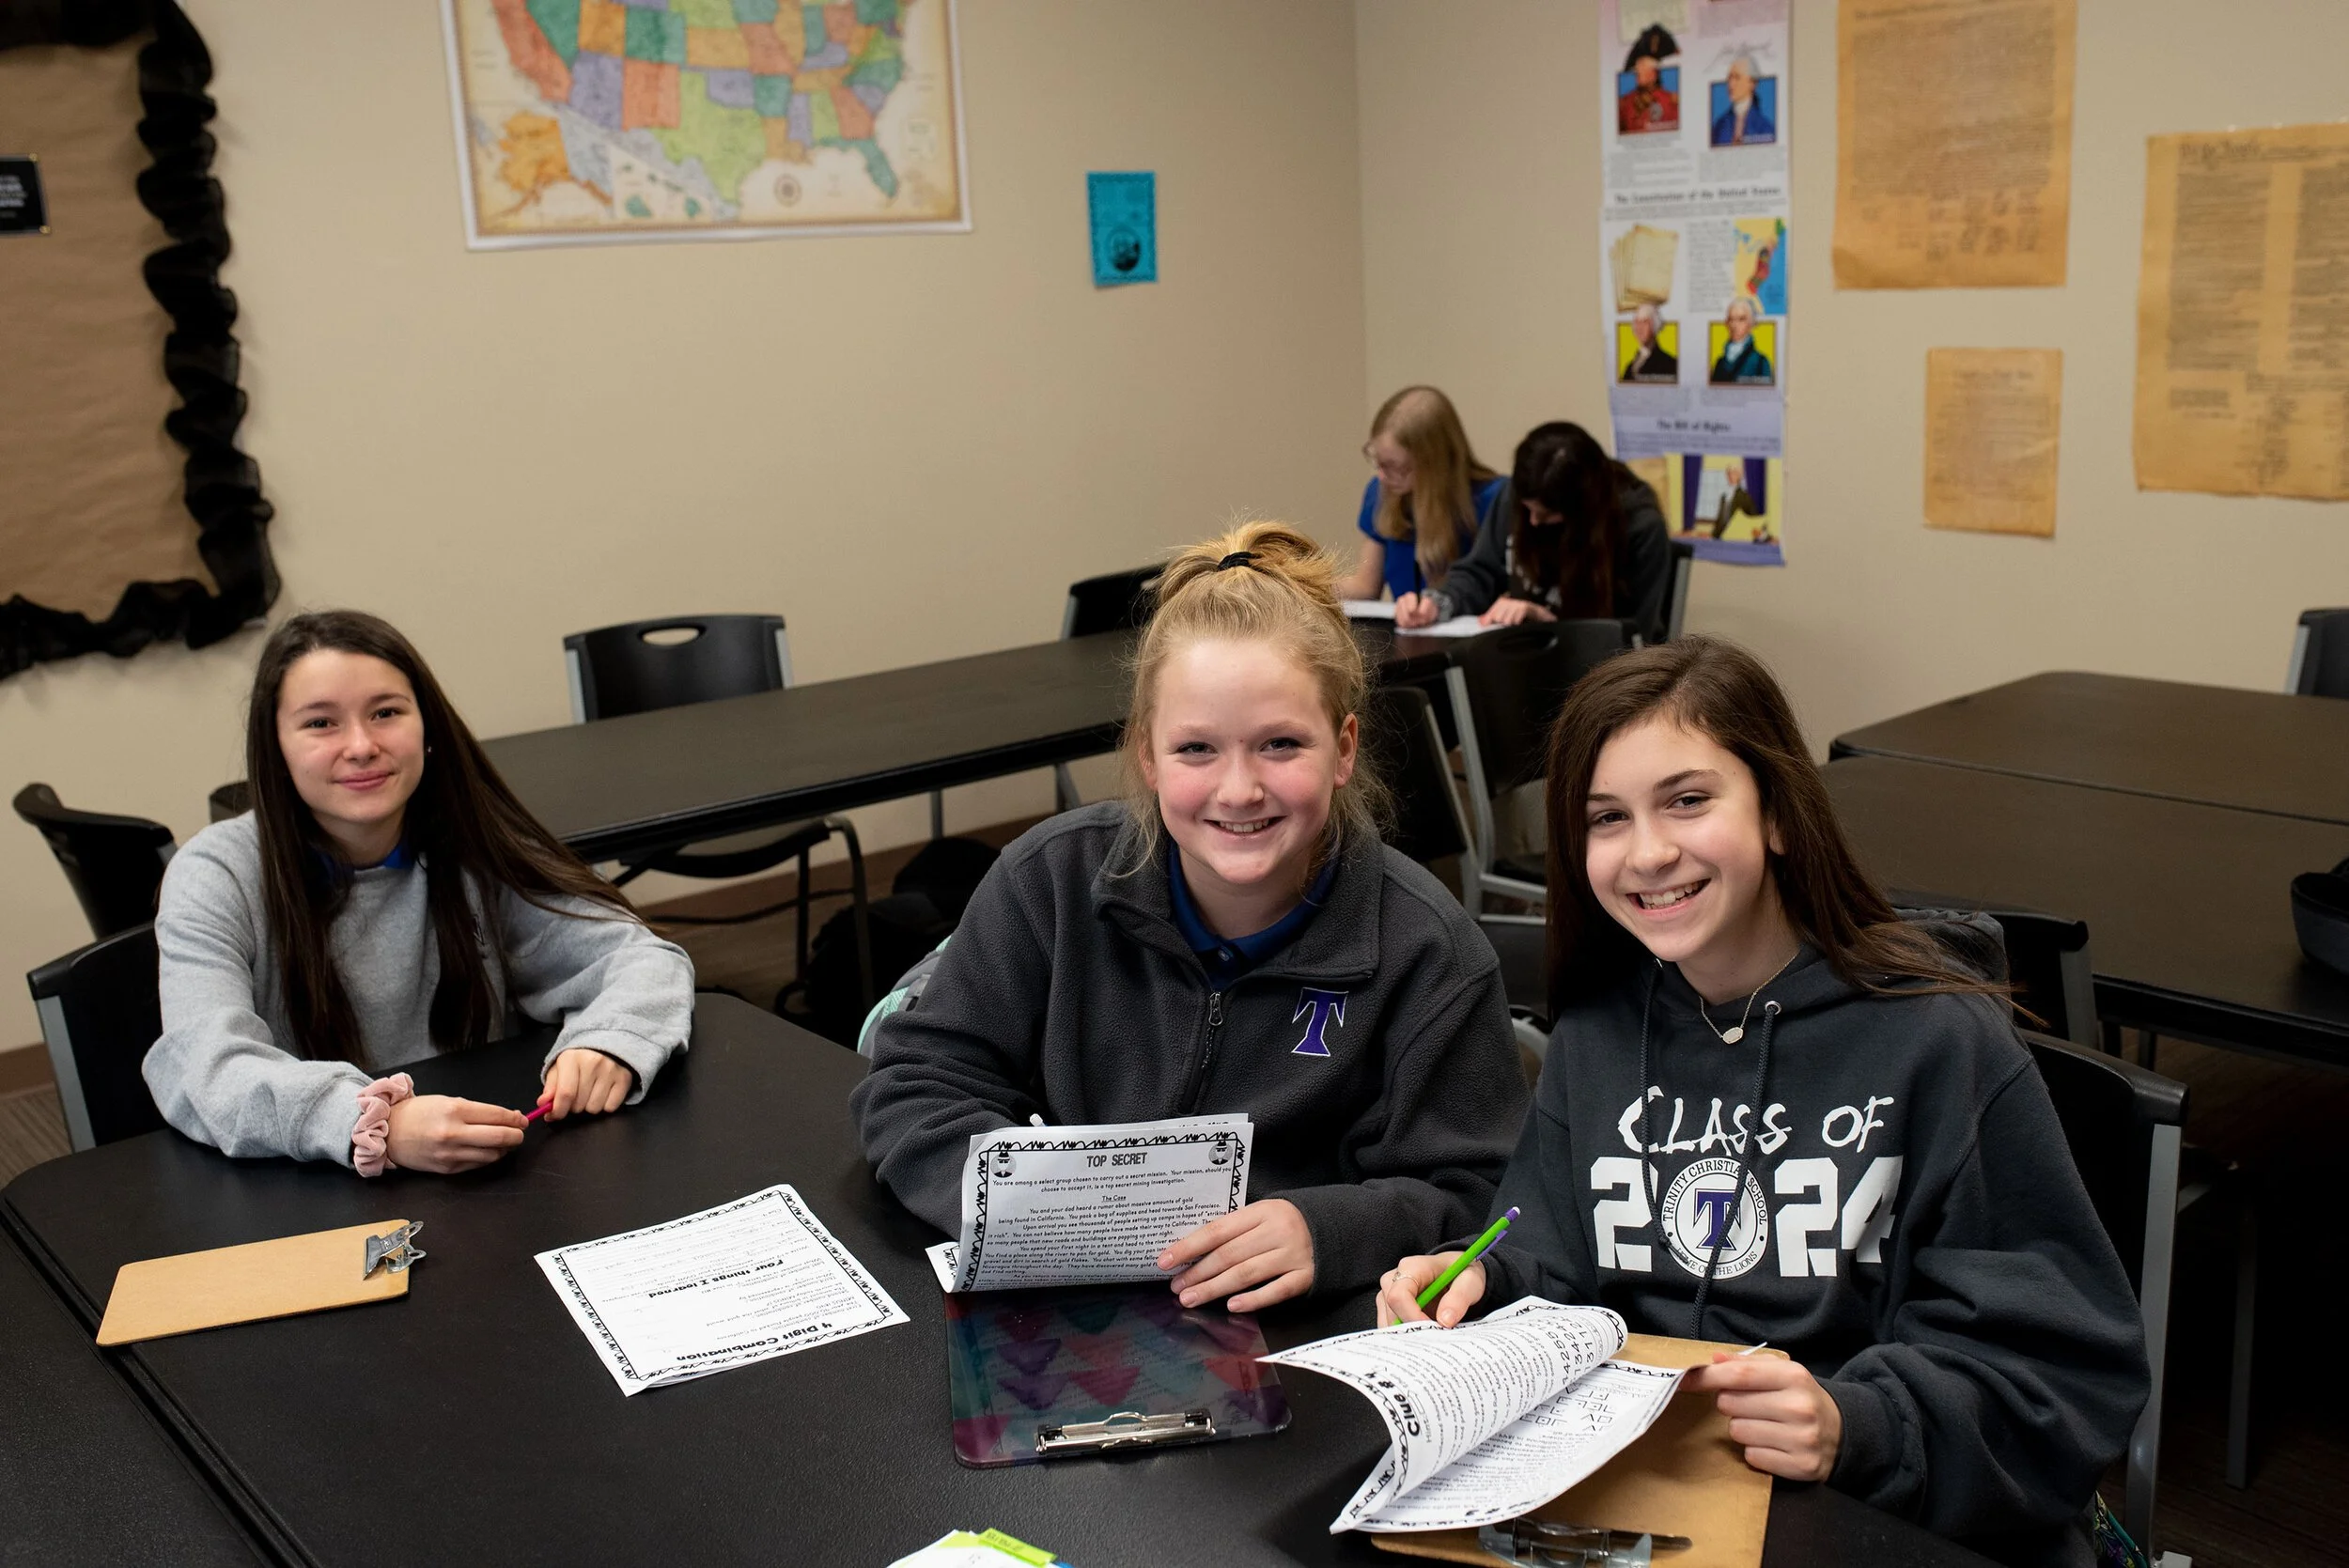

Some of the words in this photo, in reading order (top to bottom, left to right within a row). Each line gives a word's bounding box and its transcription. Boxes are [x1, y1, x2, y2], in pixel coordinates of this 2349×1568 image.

[1291, 986, 1349, 1057] T
[1087, 1155, 1107, 1167] TOP
[1112, 1152, 1148, 1166] SECRET
[1663, 1173, 1689, 1222] TRINITY
[1688, 1159, 1747, 1178] CHRISTIA
[1747, 1177, 1767, 1225] SCHOOL
[1181, 1196, 1193, 1205] gold
[1079, 1212, 1091, 1220] pack
[1114, 1217, 1131, 1226] people
[1693, 1188, 1742, 1251] T
[1092, 1227, 1109, 1235] people
[754, 1259, 783, 1271] Four
[1735, 1251, 1758, 1273] LIONS
[712, 1270, 750, 1282] things
[649, 1283, 698, 1298] learned
[783, 1325, 818, 1339] Digit
[677, 1337, 778, 1361] Combination
[1393, 1394, 1420, 1436] Clue
